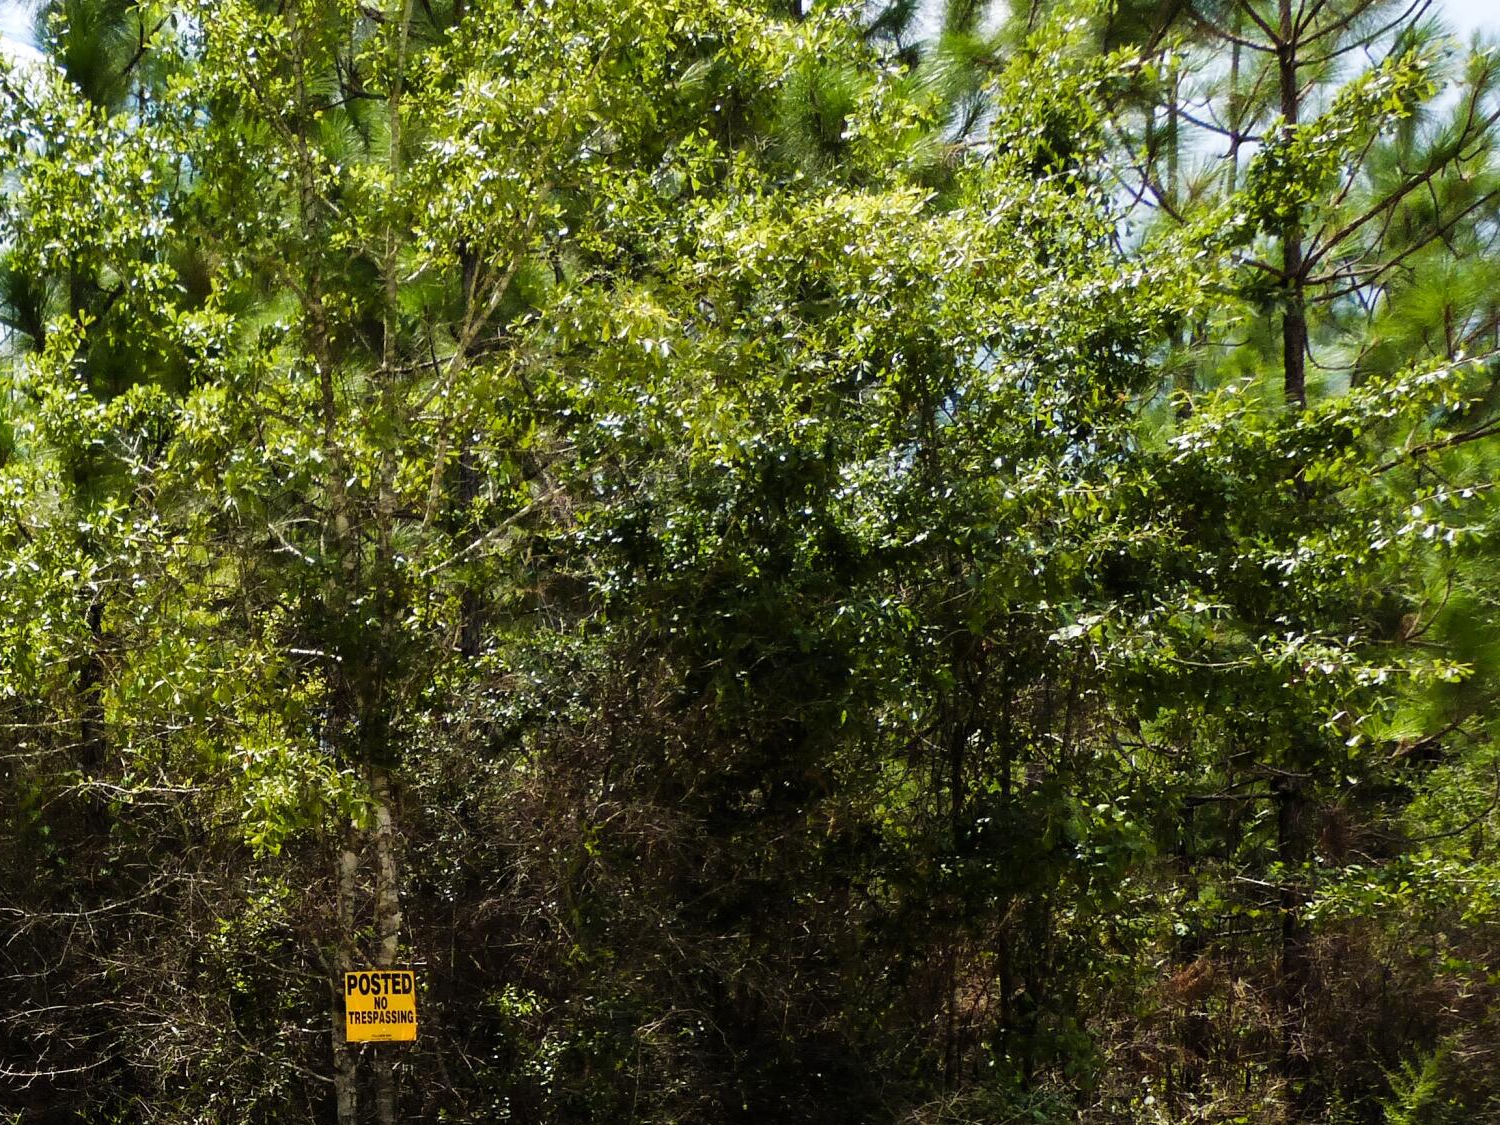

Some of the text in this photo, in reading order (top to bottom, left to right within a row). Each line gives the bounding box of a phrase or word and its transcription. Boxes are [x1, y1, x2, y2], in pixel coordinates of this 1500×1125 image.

[346, 973, 413, 996] POSTED
[373, 996, 388, 1010] NO
[348, 1010, 414, 1025] TRESPASSING
